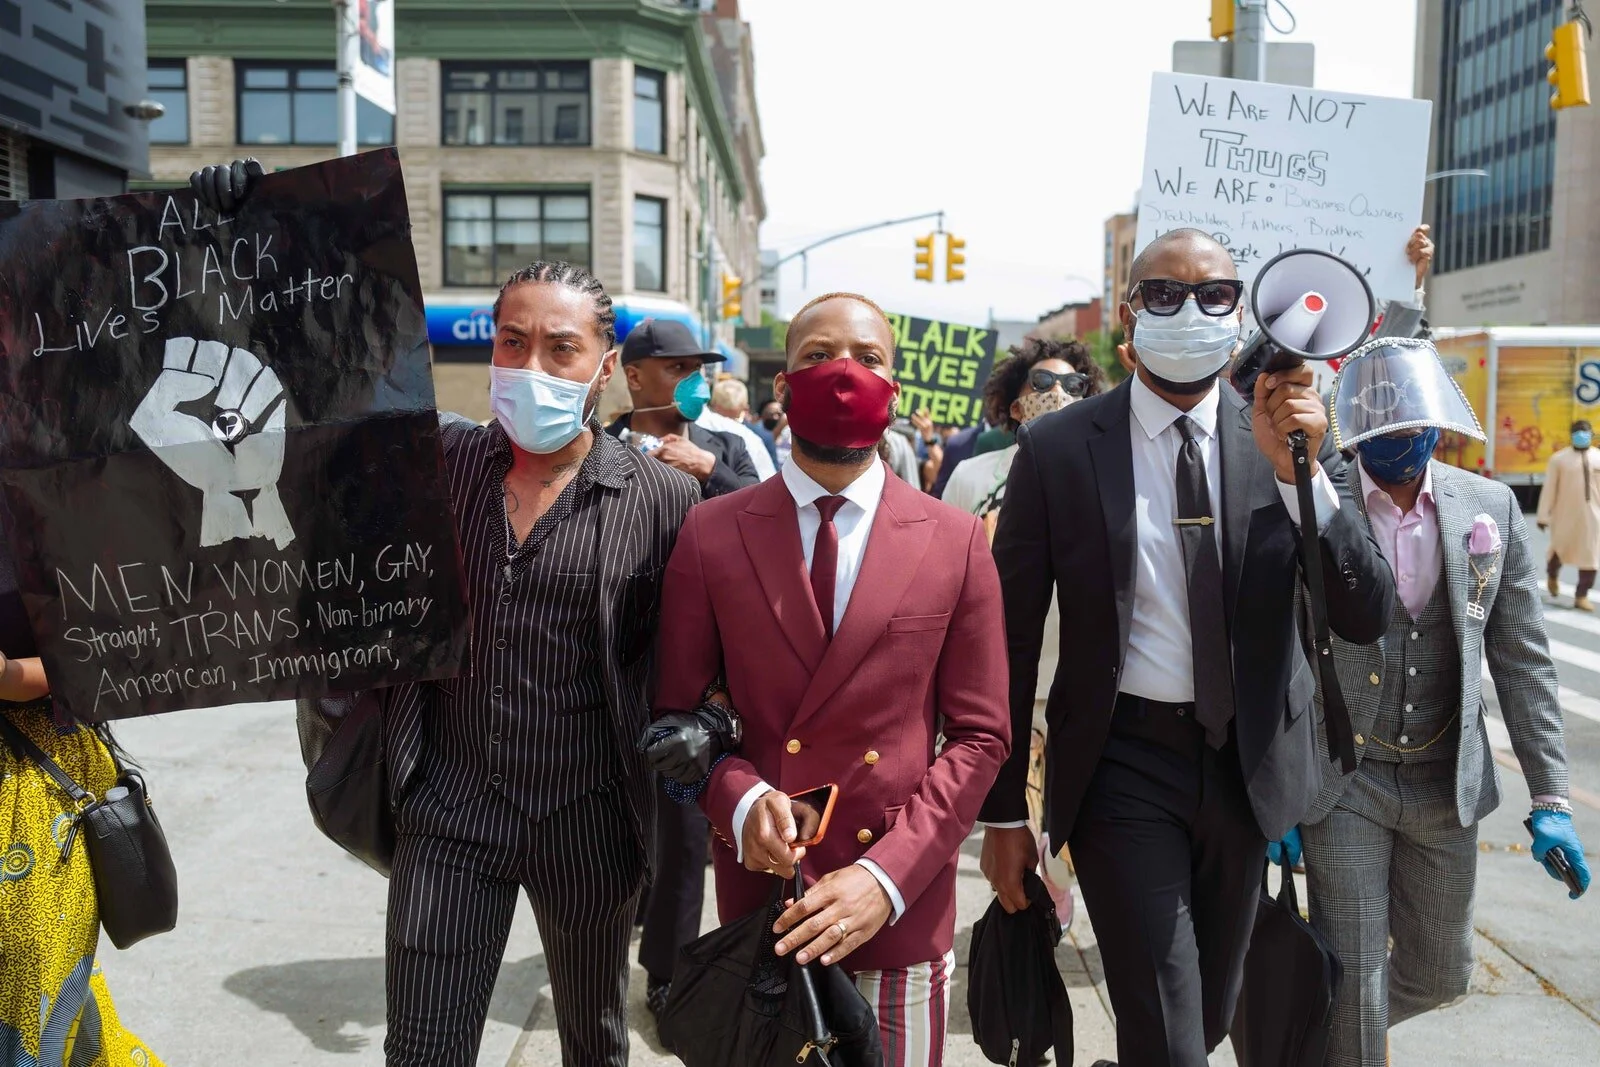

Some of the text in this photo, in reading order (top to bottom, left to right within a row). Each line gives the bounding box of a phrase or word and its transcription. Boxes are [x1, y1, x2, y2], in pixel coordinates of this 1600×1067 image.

[1287, 94, 1367, 129] NOT
[1200, 128, 1329, 187] THUGS
[1348, 193, 1404, 222] Owners
[127, 233, 278, 311] BLACK
[33, 267, 354, 357] Lives Matter
[452, 314, 497, 341] citi
[892, 351, 979, 389] IVES
[895, 384, 983, 428] TTER!
[56, 543, 435, 621] MEN, WOMEN, GAY,
[63, 623, 161, 662] Straight,
[317, 596, 433, 629] Non-binary
[93, 630, 400, 712] American, Immigrant,
